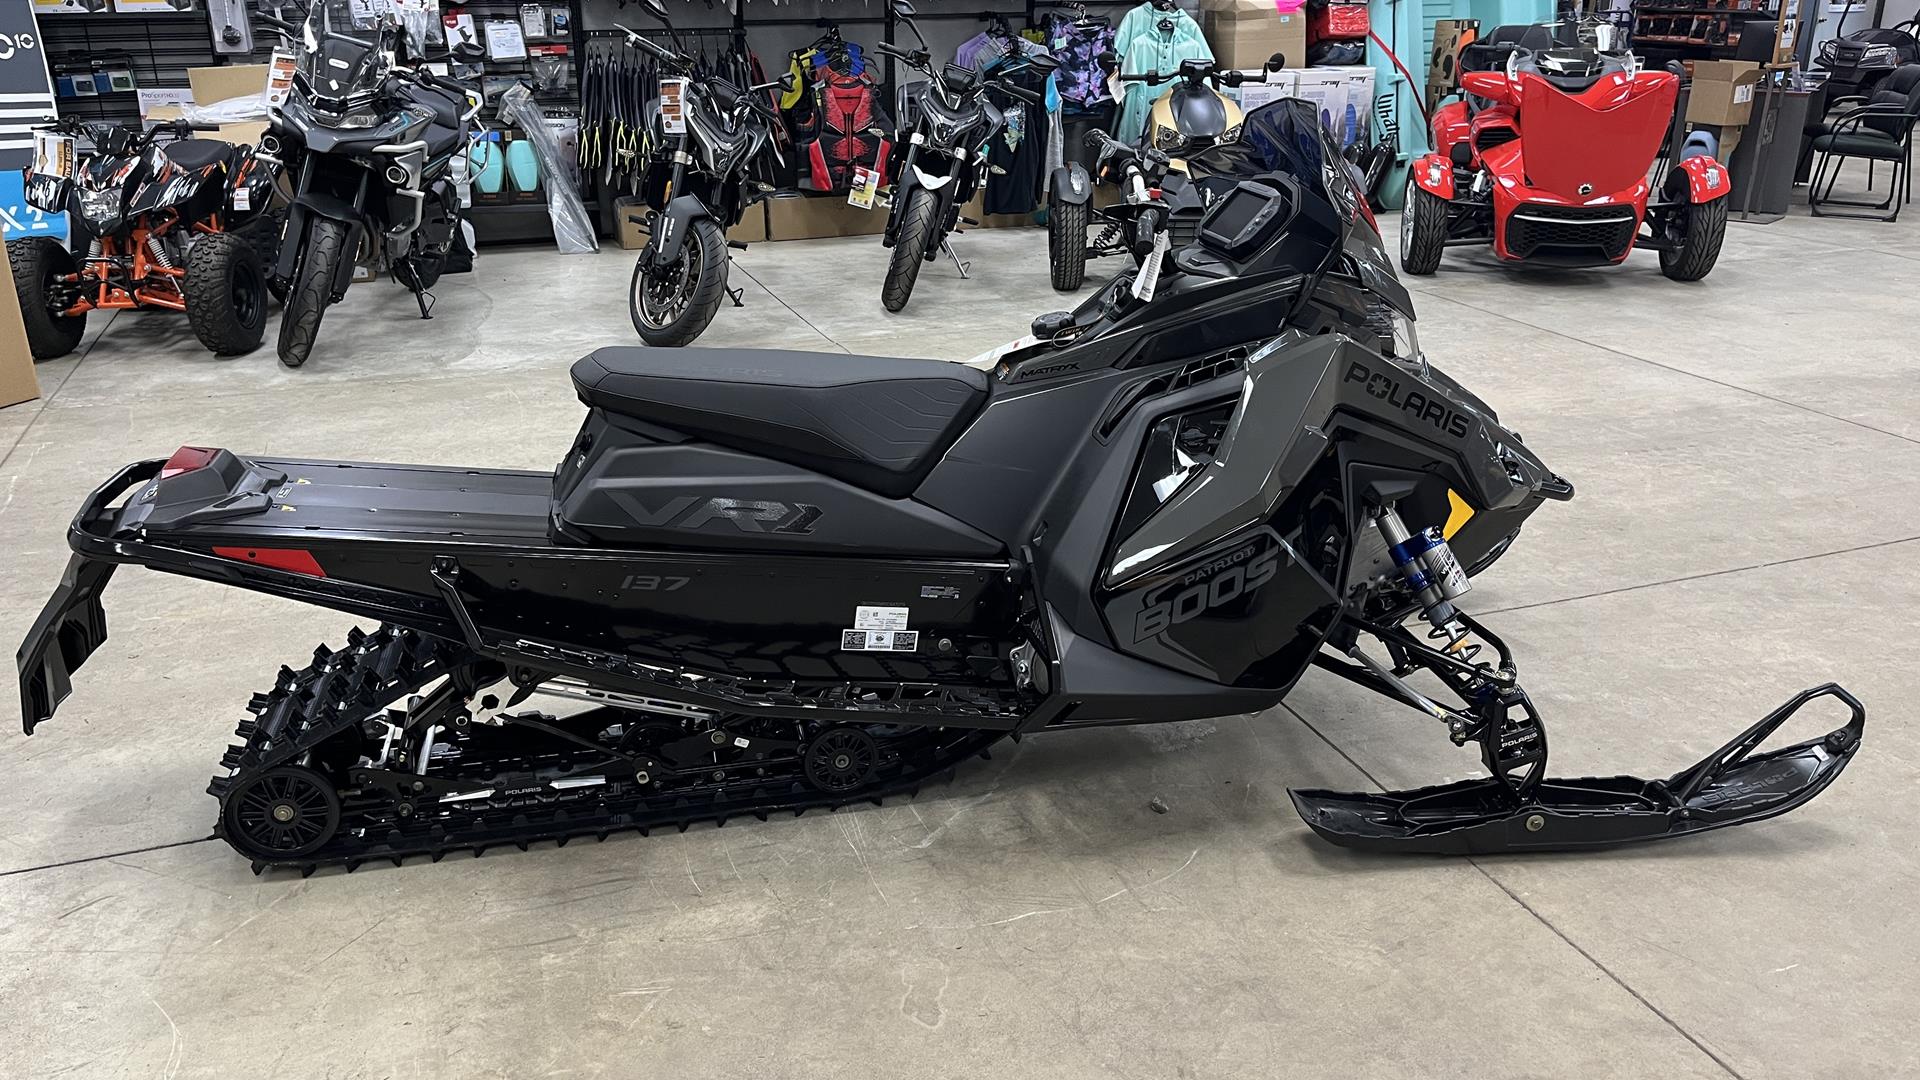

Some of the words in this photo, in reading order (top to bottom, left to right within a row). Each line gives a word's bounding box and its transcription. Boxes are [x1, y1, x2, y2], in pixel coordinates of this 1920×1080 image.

[1020, 363, 1081, 379] MATRYX
[1343, 361, 1470, 439] POLARIS
[1184, 545, 1256, 587] PATRIOT
[620, 575, 691, 592] 137
[1501, 732, 1538, 748] POLARIS
[505, 787, 542, 796] POLARIS
